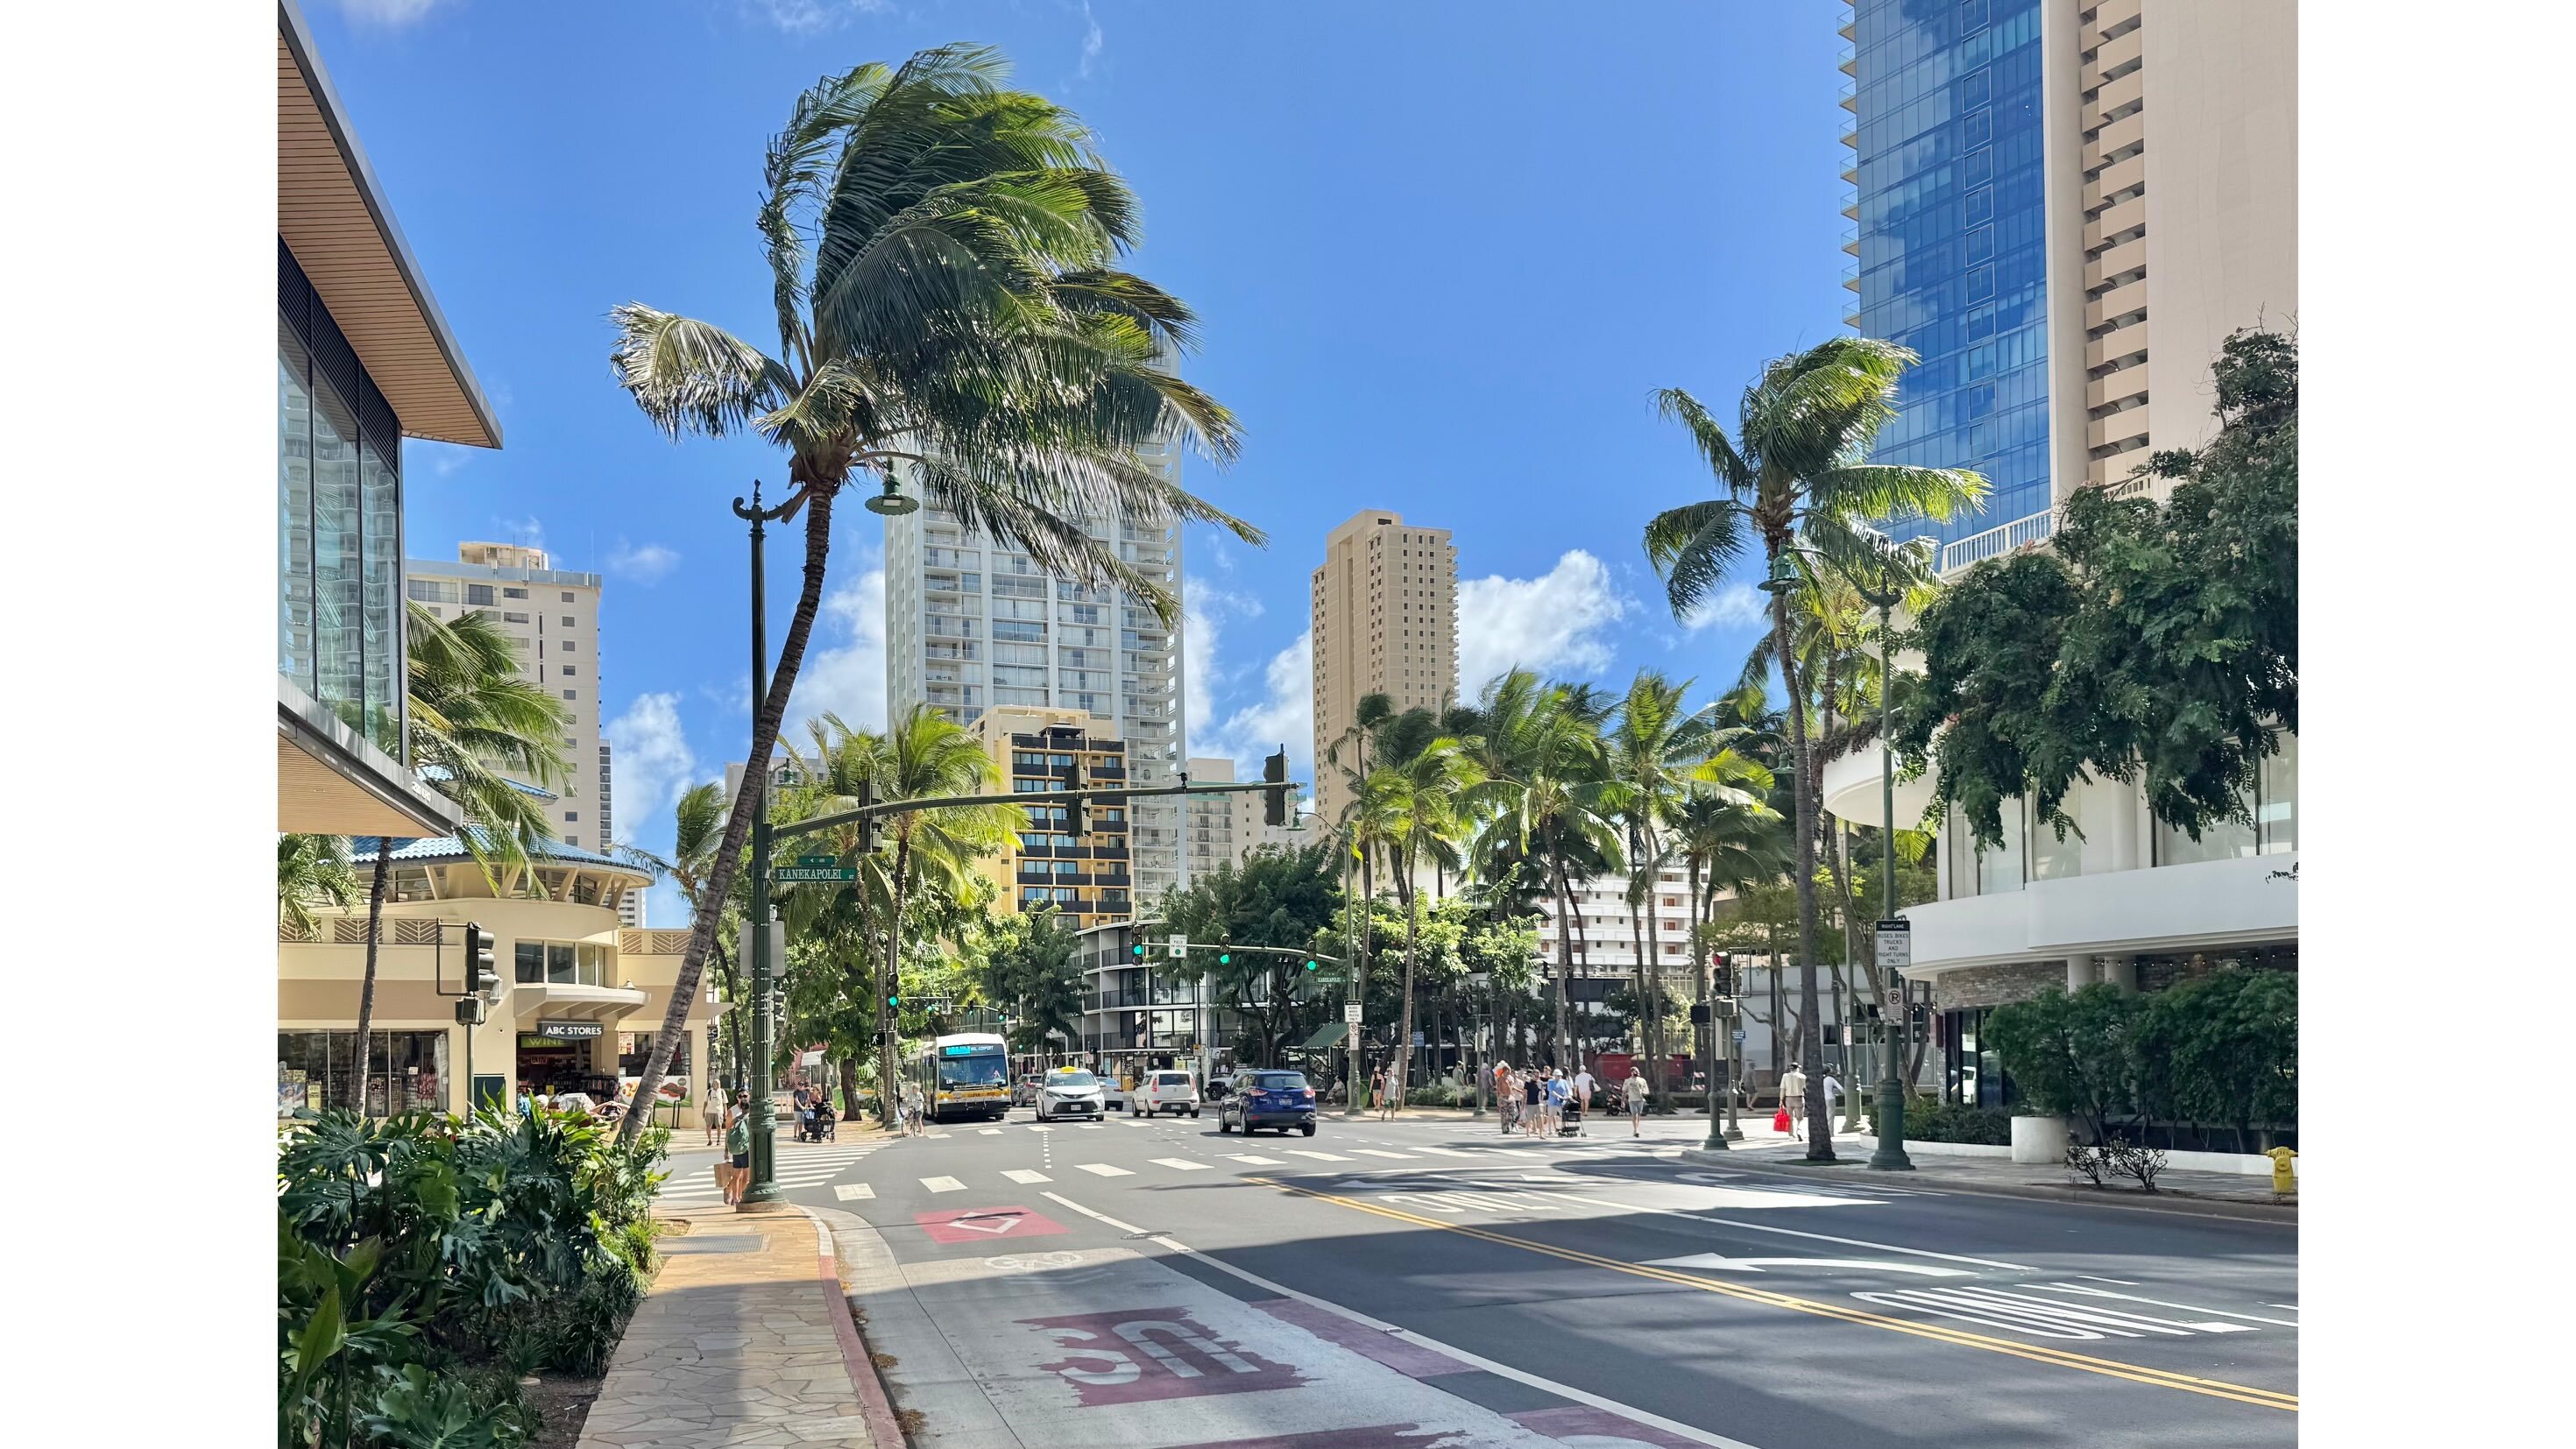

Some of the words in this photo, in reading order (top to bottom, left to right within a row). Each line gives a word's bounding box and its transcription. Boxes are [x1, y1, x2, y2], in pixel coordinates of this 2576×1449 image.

[778, 868, 841, 880] KANEKAPOLEI
[546, 1026, 565, 1035] ABC
[567, 1027, 602, 1036] STORES
[1848, 1282, 2298, 1340] ONLY
